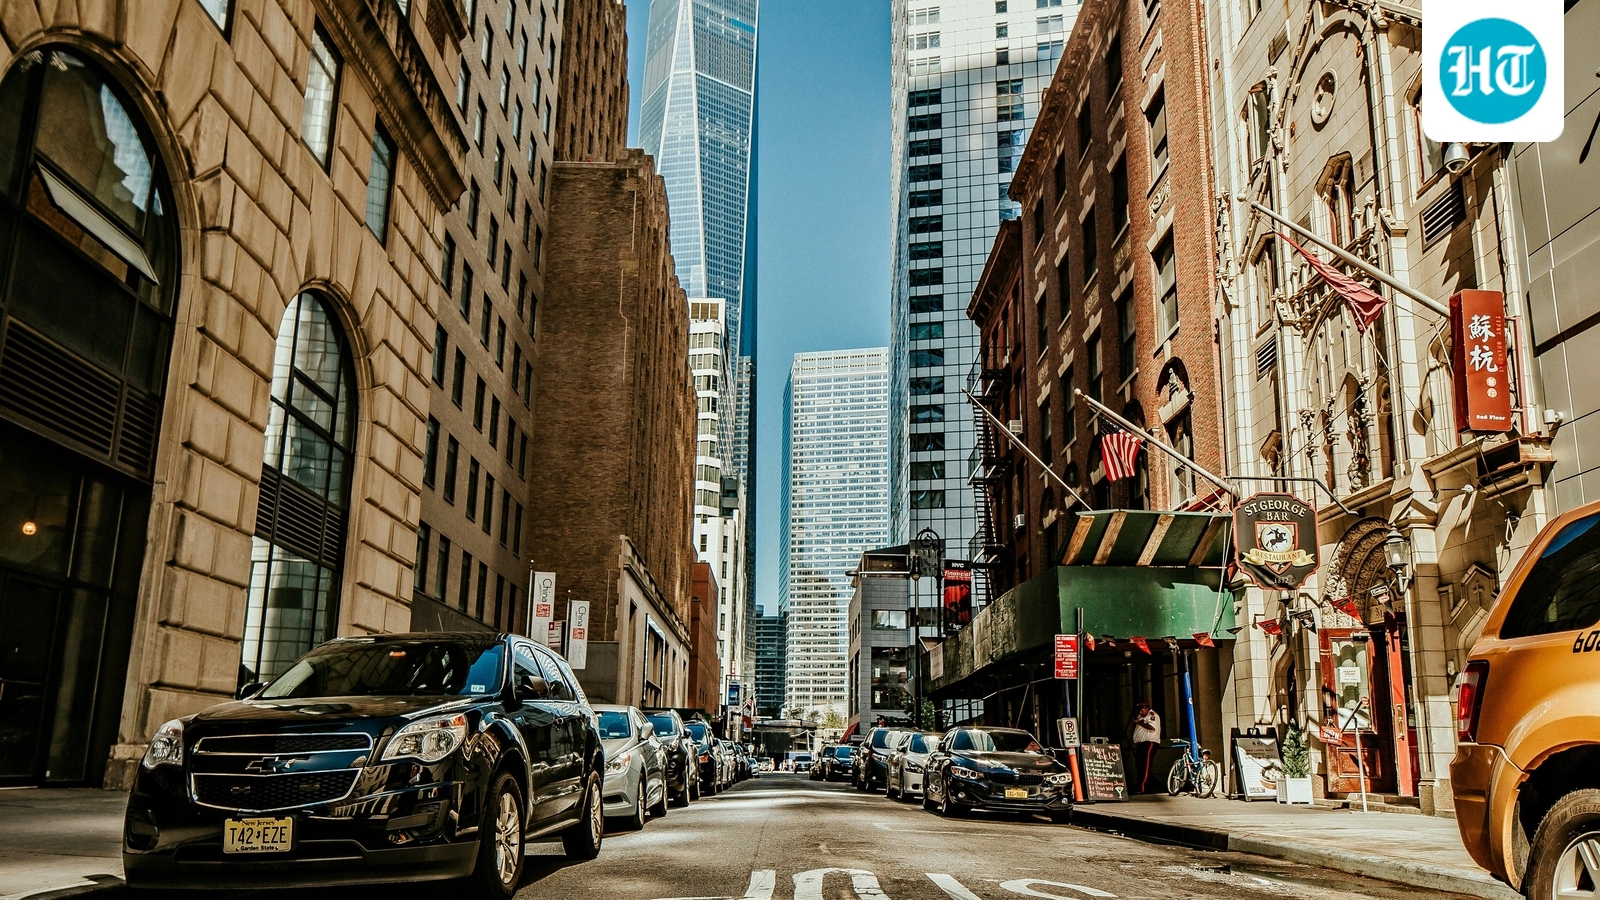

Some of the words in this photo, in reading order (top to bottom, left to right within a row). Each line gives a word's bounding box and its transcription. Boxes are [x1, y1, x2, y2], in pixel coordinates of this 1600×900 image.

[1266, 512, 1290, 521] BAR
[1255, 552, 1301, 560] RESTAURANT
[542, 578, 552, 602] China
[577, 606, 586, 626] China
